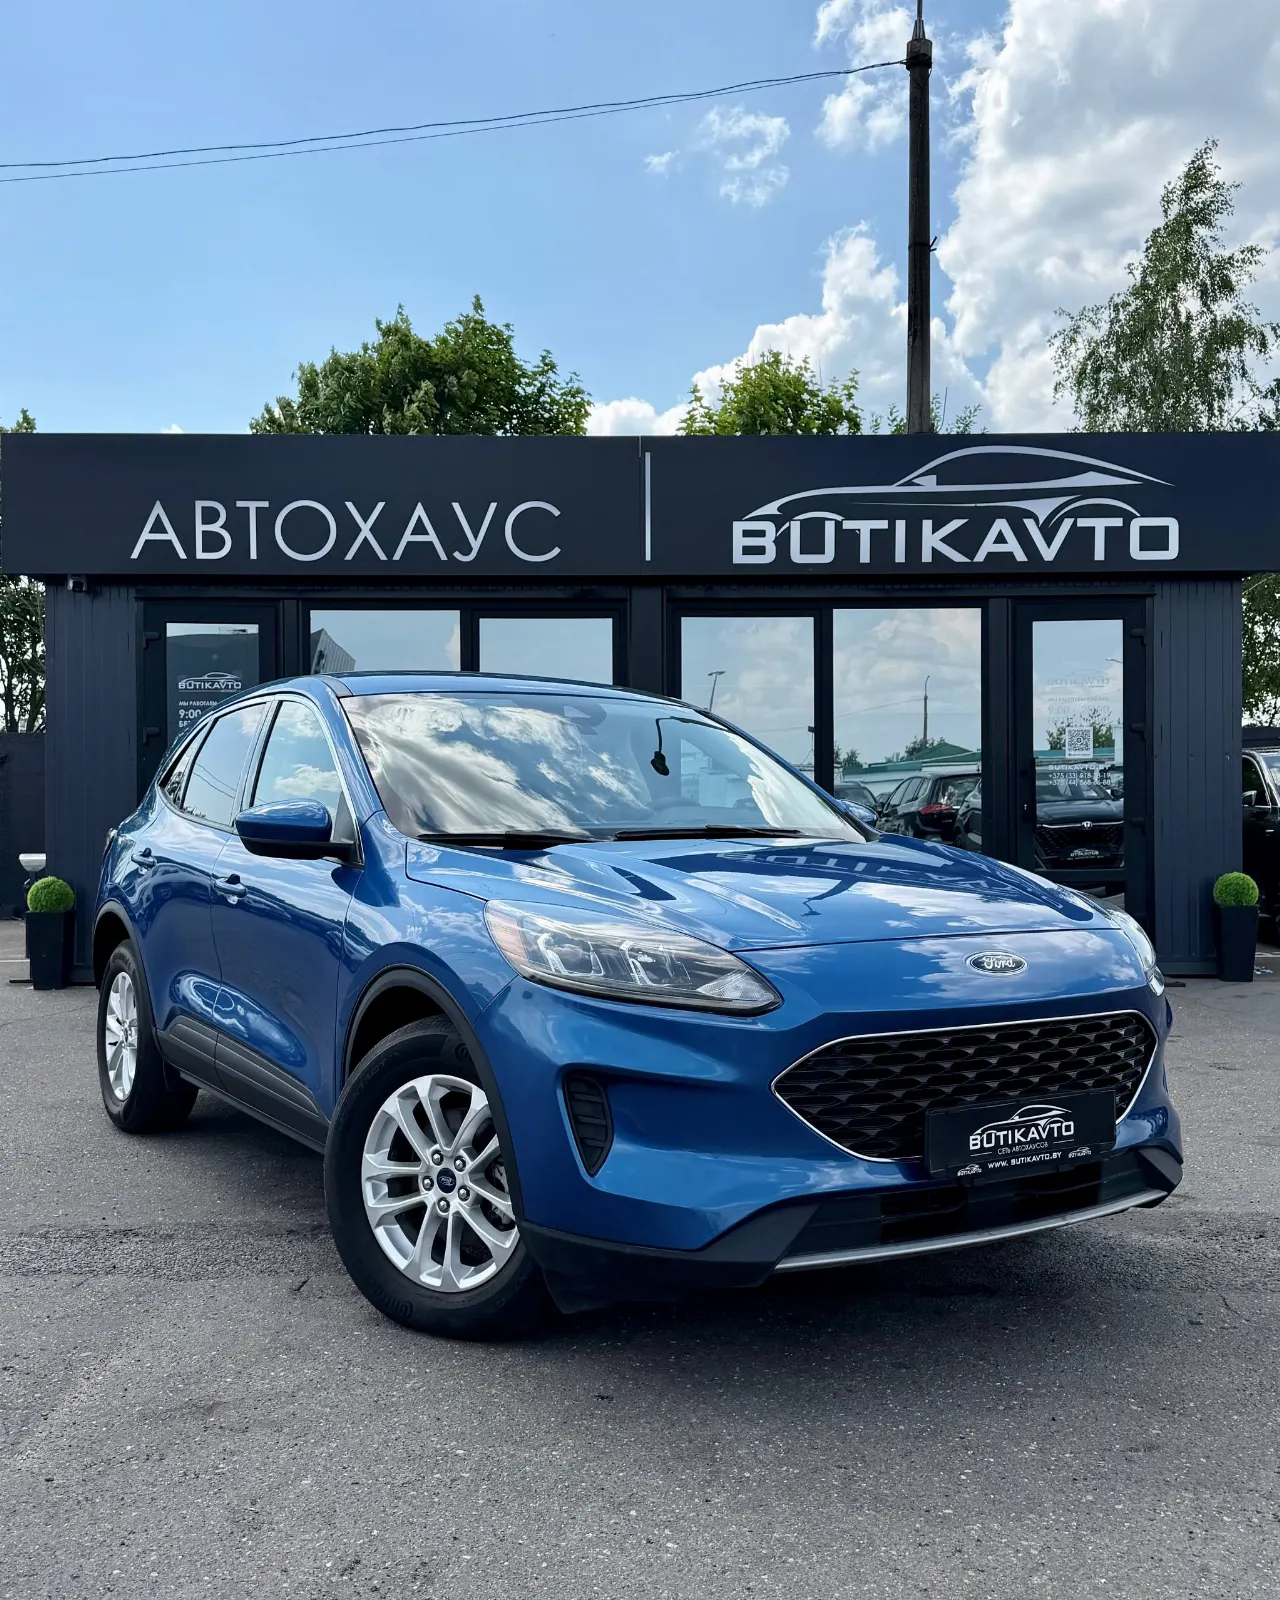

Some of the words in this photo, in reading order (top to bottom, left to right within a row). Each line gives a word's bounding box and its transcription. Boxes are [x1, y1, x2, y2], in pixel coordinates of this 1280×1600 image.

[131, 499, 563, 563] АВТОХАУС
[732, 516, 1180, 564] BUTIKAVTO
[178, 681, 241, 689] BUTIKAVTO
[981, 956, 1016, 969] Ford
[969, 1121, 1075, 1150] BUTIKAVTO
